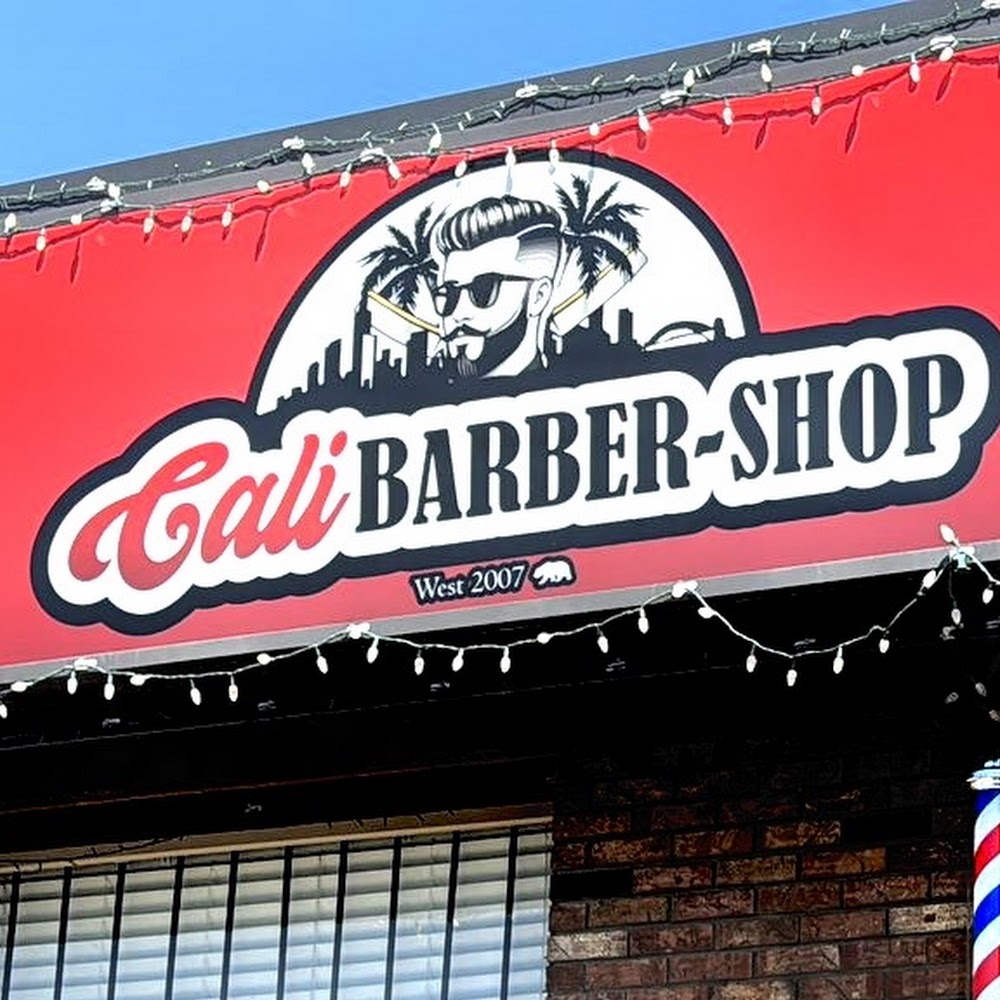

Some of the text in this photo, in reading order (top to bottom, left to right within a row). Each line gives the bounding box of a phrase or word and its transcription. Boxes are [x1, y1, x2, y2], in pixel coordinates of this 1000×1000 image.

[68, 353, 965, 591] Cali BARBER-SHOP
[414, 565, 525, 601] West 2007
